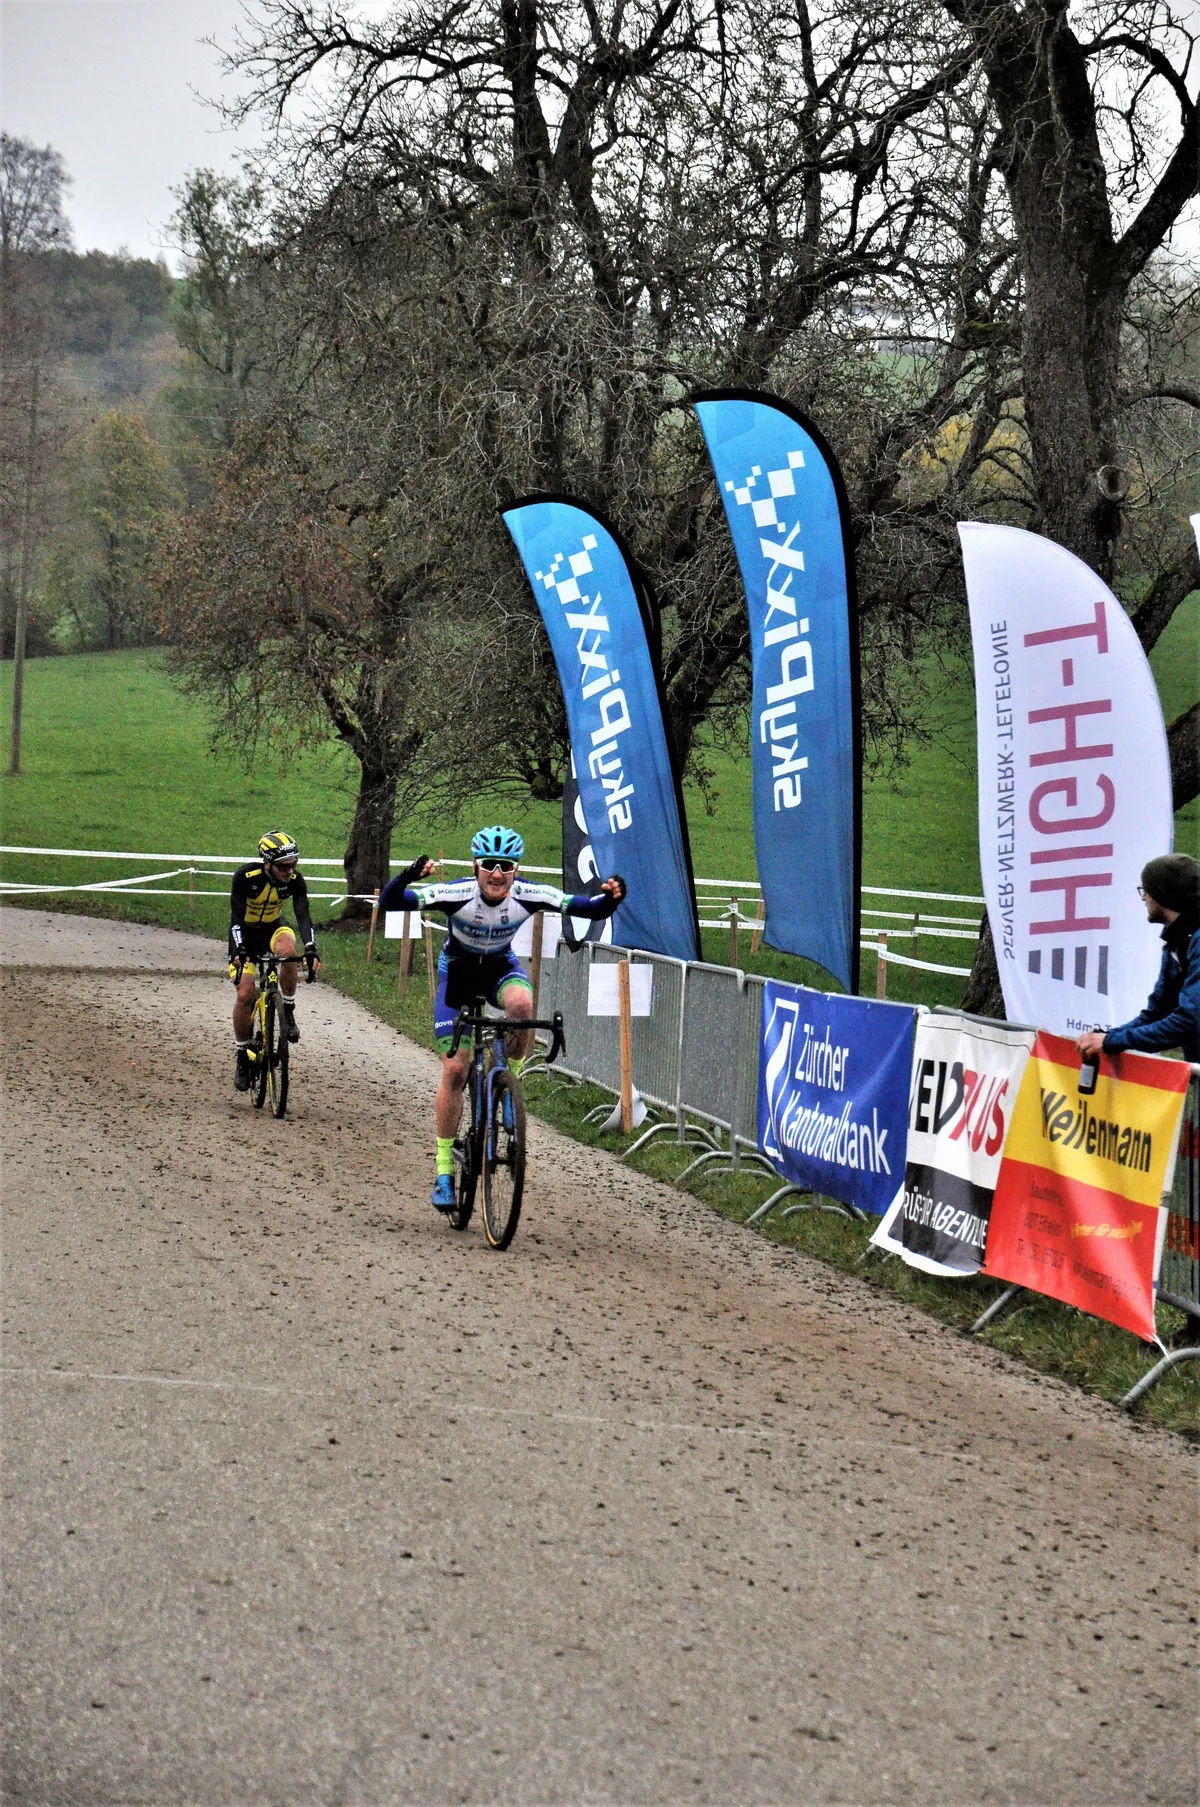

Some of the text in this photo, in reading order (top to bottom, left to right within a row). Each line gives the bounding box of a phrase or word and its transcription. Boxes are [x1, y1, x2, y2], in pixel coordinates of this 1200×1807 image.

[794, 1024, 849, 1092] Zürcher
[779, 1092, 891, 1176] Kantonalbank
[1040, 1088, 1152, 1173] Weilenmann
